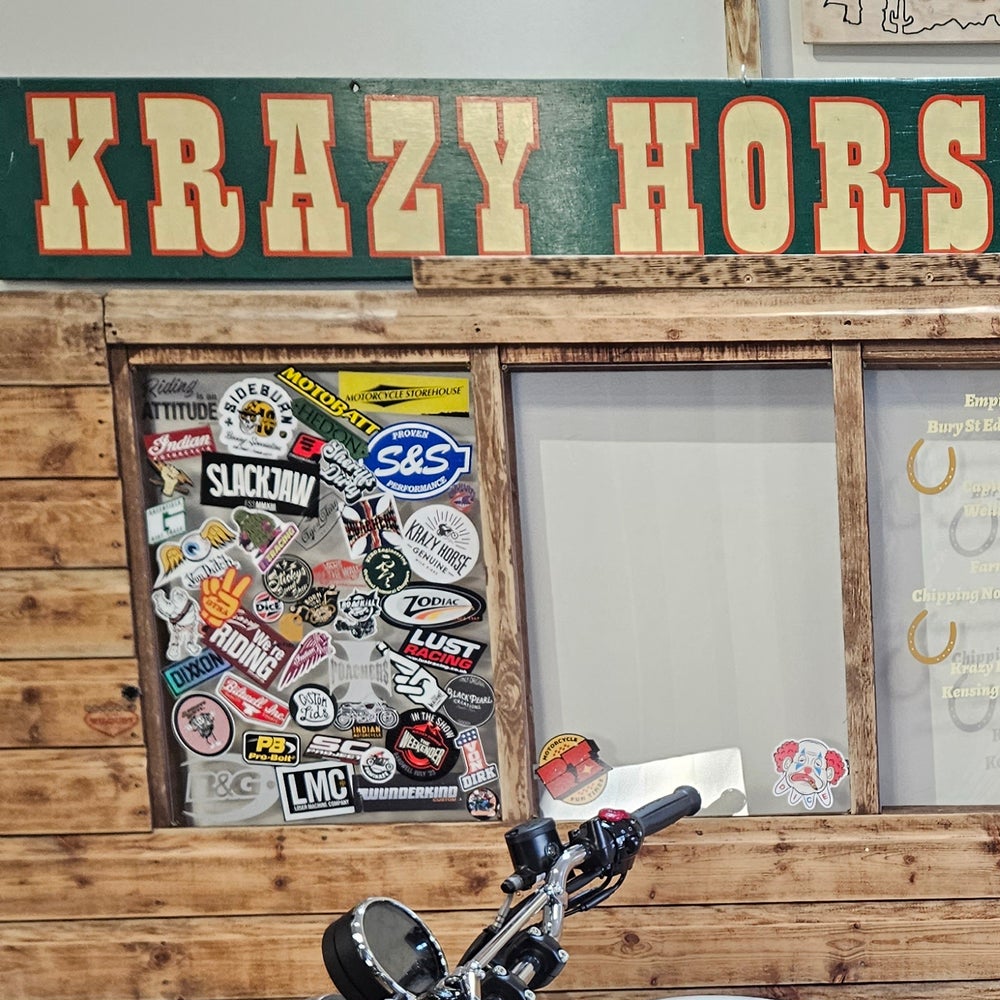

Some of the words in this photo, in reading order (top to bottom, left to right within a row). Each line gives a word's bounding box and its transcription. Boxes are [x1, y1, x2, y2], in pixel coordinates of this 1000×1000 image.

[25, 91, 540, 257] KRAZY
[224, 383, 293, 425] SIDEBURN
[281, 367, 380, 435] MOTOBATT
[346, 390, 404, 402] MOTORCYCLE
[406, 386, 462, 398] STOREHOUSE
[143, 401, 219, 421] ATTITUDE
[299, 403, 361, 455] HEDON
[392, 429, 429, 440] PROVEN
[926, 419, 963, 438] Bury
[965, 418, 981, 433] St
[148, 434, 212, 456] Indian
[374, 443, 451, 477] S&S
[206, 463, 316, 508] SLACKJAW
[386, 475, 447, 493] PERFORMANCE
[405, 519, 440, 550] KRAZY
[437, 542, 473, 577] HORSE
[412, 547, 449, 575] GENUINE
[403, 595, 460, 618] ZODIAC
[911, 588, 979, 604] Chipping
[209, 622, 279, 681] RIDING
[403, 643, 473, 669] RACING
[410, 629, 481, 658] LUST
[170, 652, 225, 688] DIXXON
[950, 661, 994, 677] Krazy
[410, 712, 420, 722] IN
[421, 712, 435, 722] THE
[436, 717, 455, 739] SHOW
[256, 735, 287, 753] PB
[542, 736, 578, 761] MOTORCYCLE
[288, 768, 348, 806] LMC
[463, 766, 497, 788] DIRK
